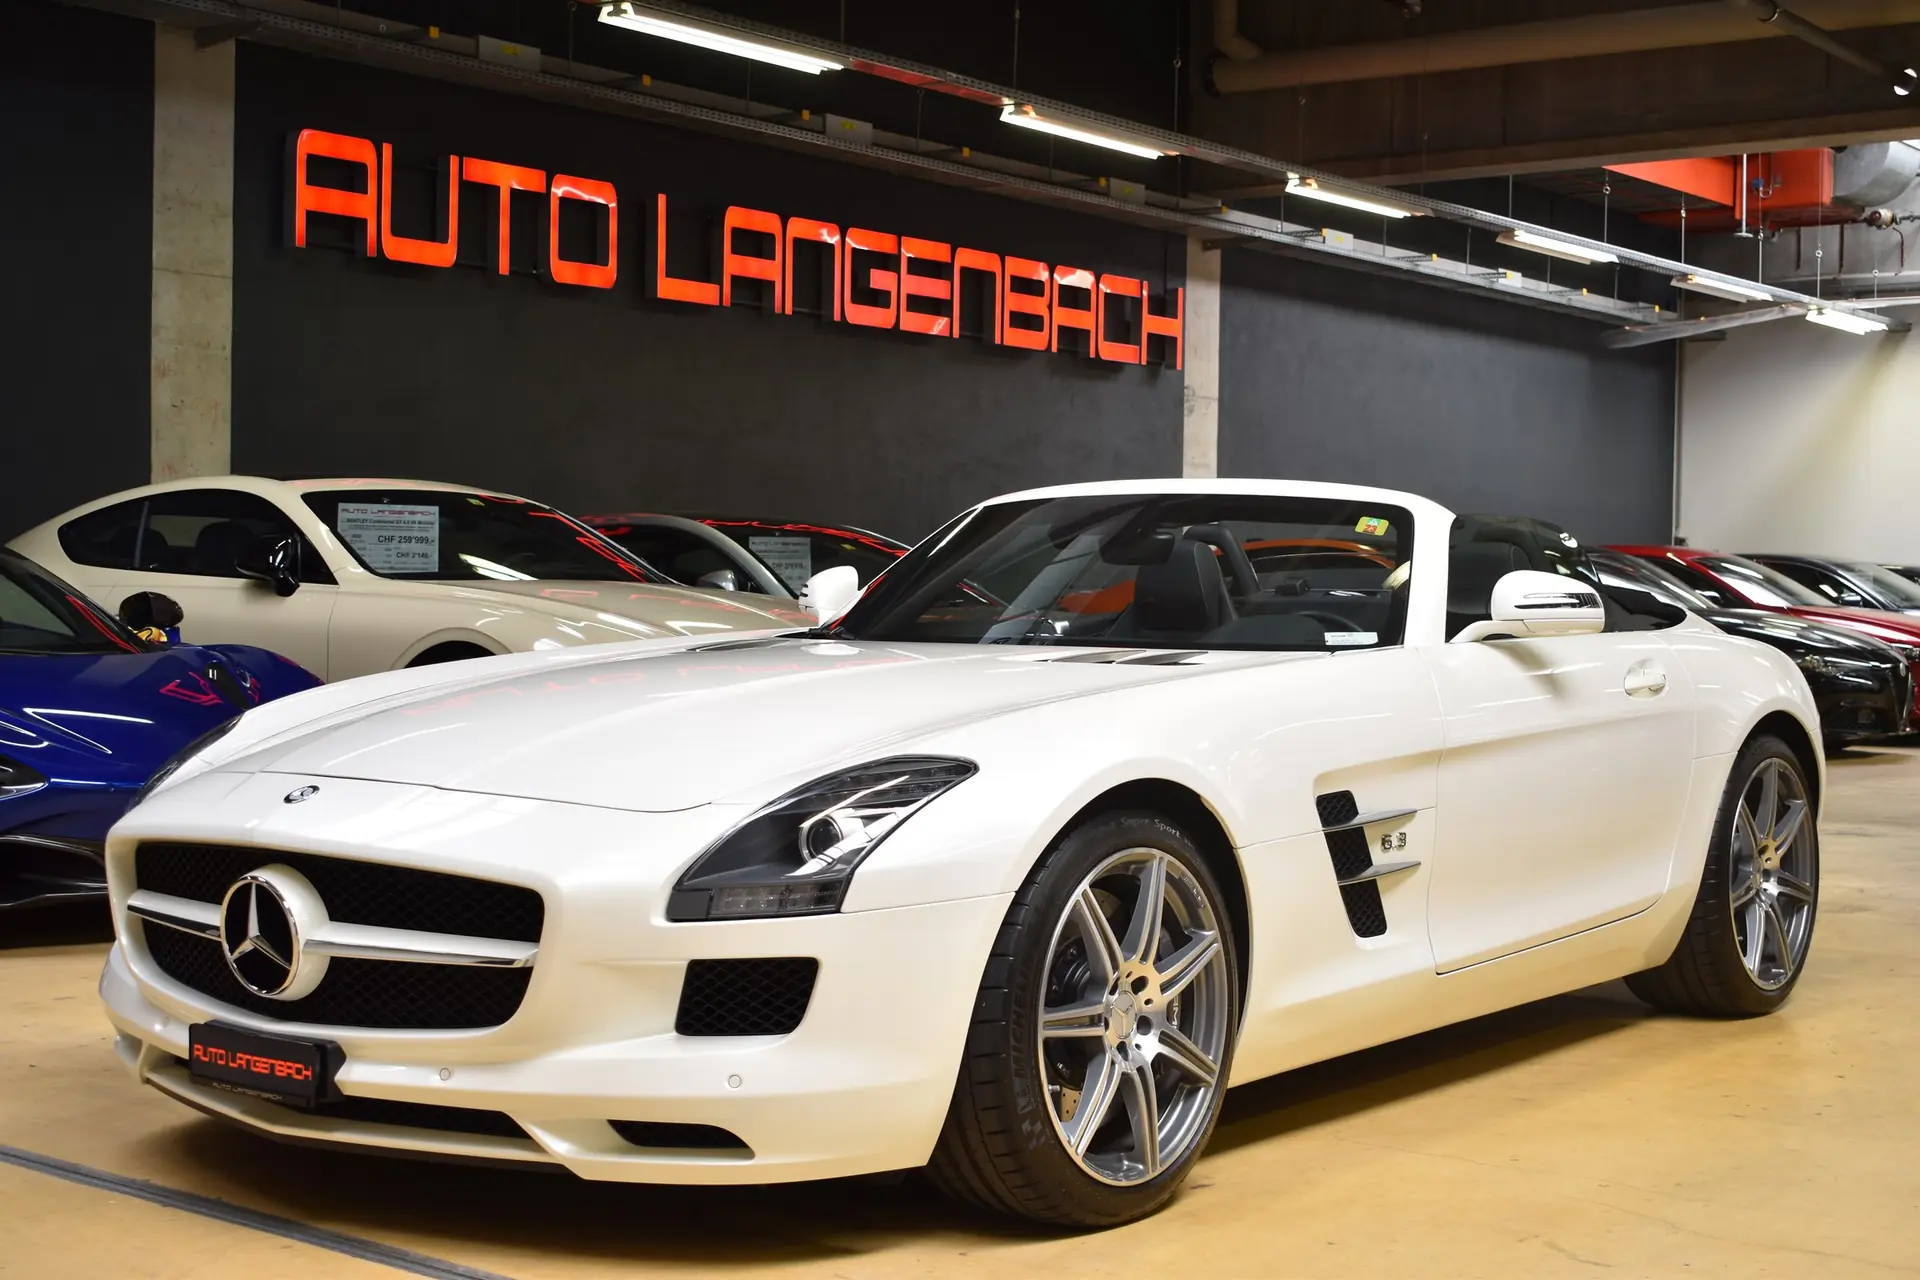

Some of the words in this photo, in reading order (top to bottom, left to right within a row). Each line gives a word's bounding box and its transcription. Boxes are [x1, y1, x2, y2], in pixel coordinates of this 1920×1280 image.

[294, 128, 618, 290] AUTO
[656, 192, 1186, 371] LANGENBACH
[377, 535, 395, 543] CHF
[1154, 819, 1181, 838] Sport
[1381, 832, 1407, 851] 6.3
[193, 1044, 226, 1065] AUTO
[229, 1052, 312, 1081] LANGENBACH
[212, 1082, 231, 1091] AUTO
